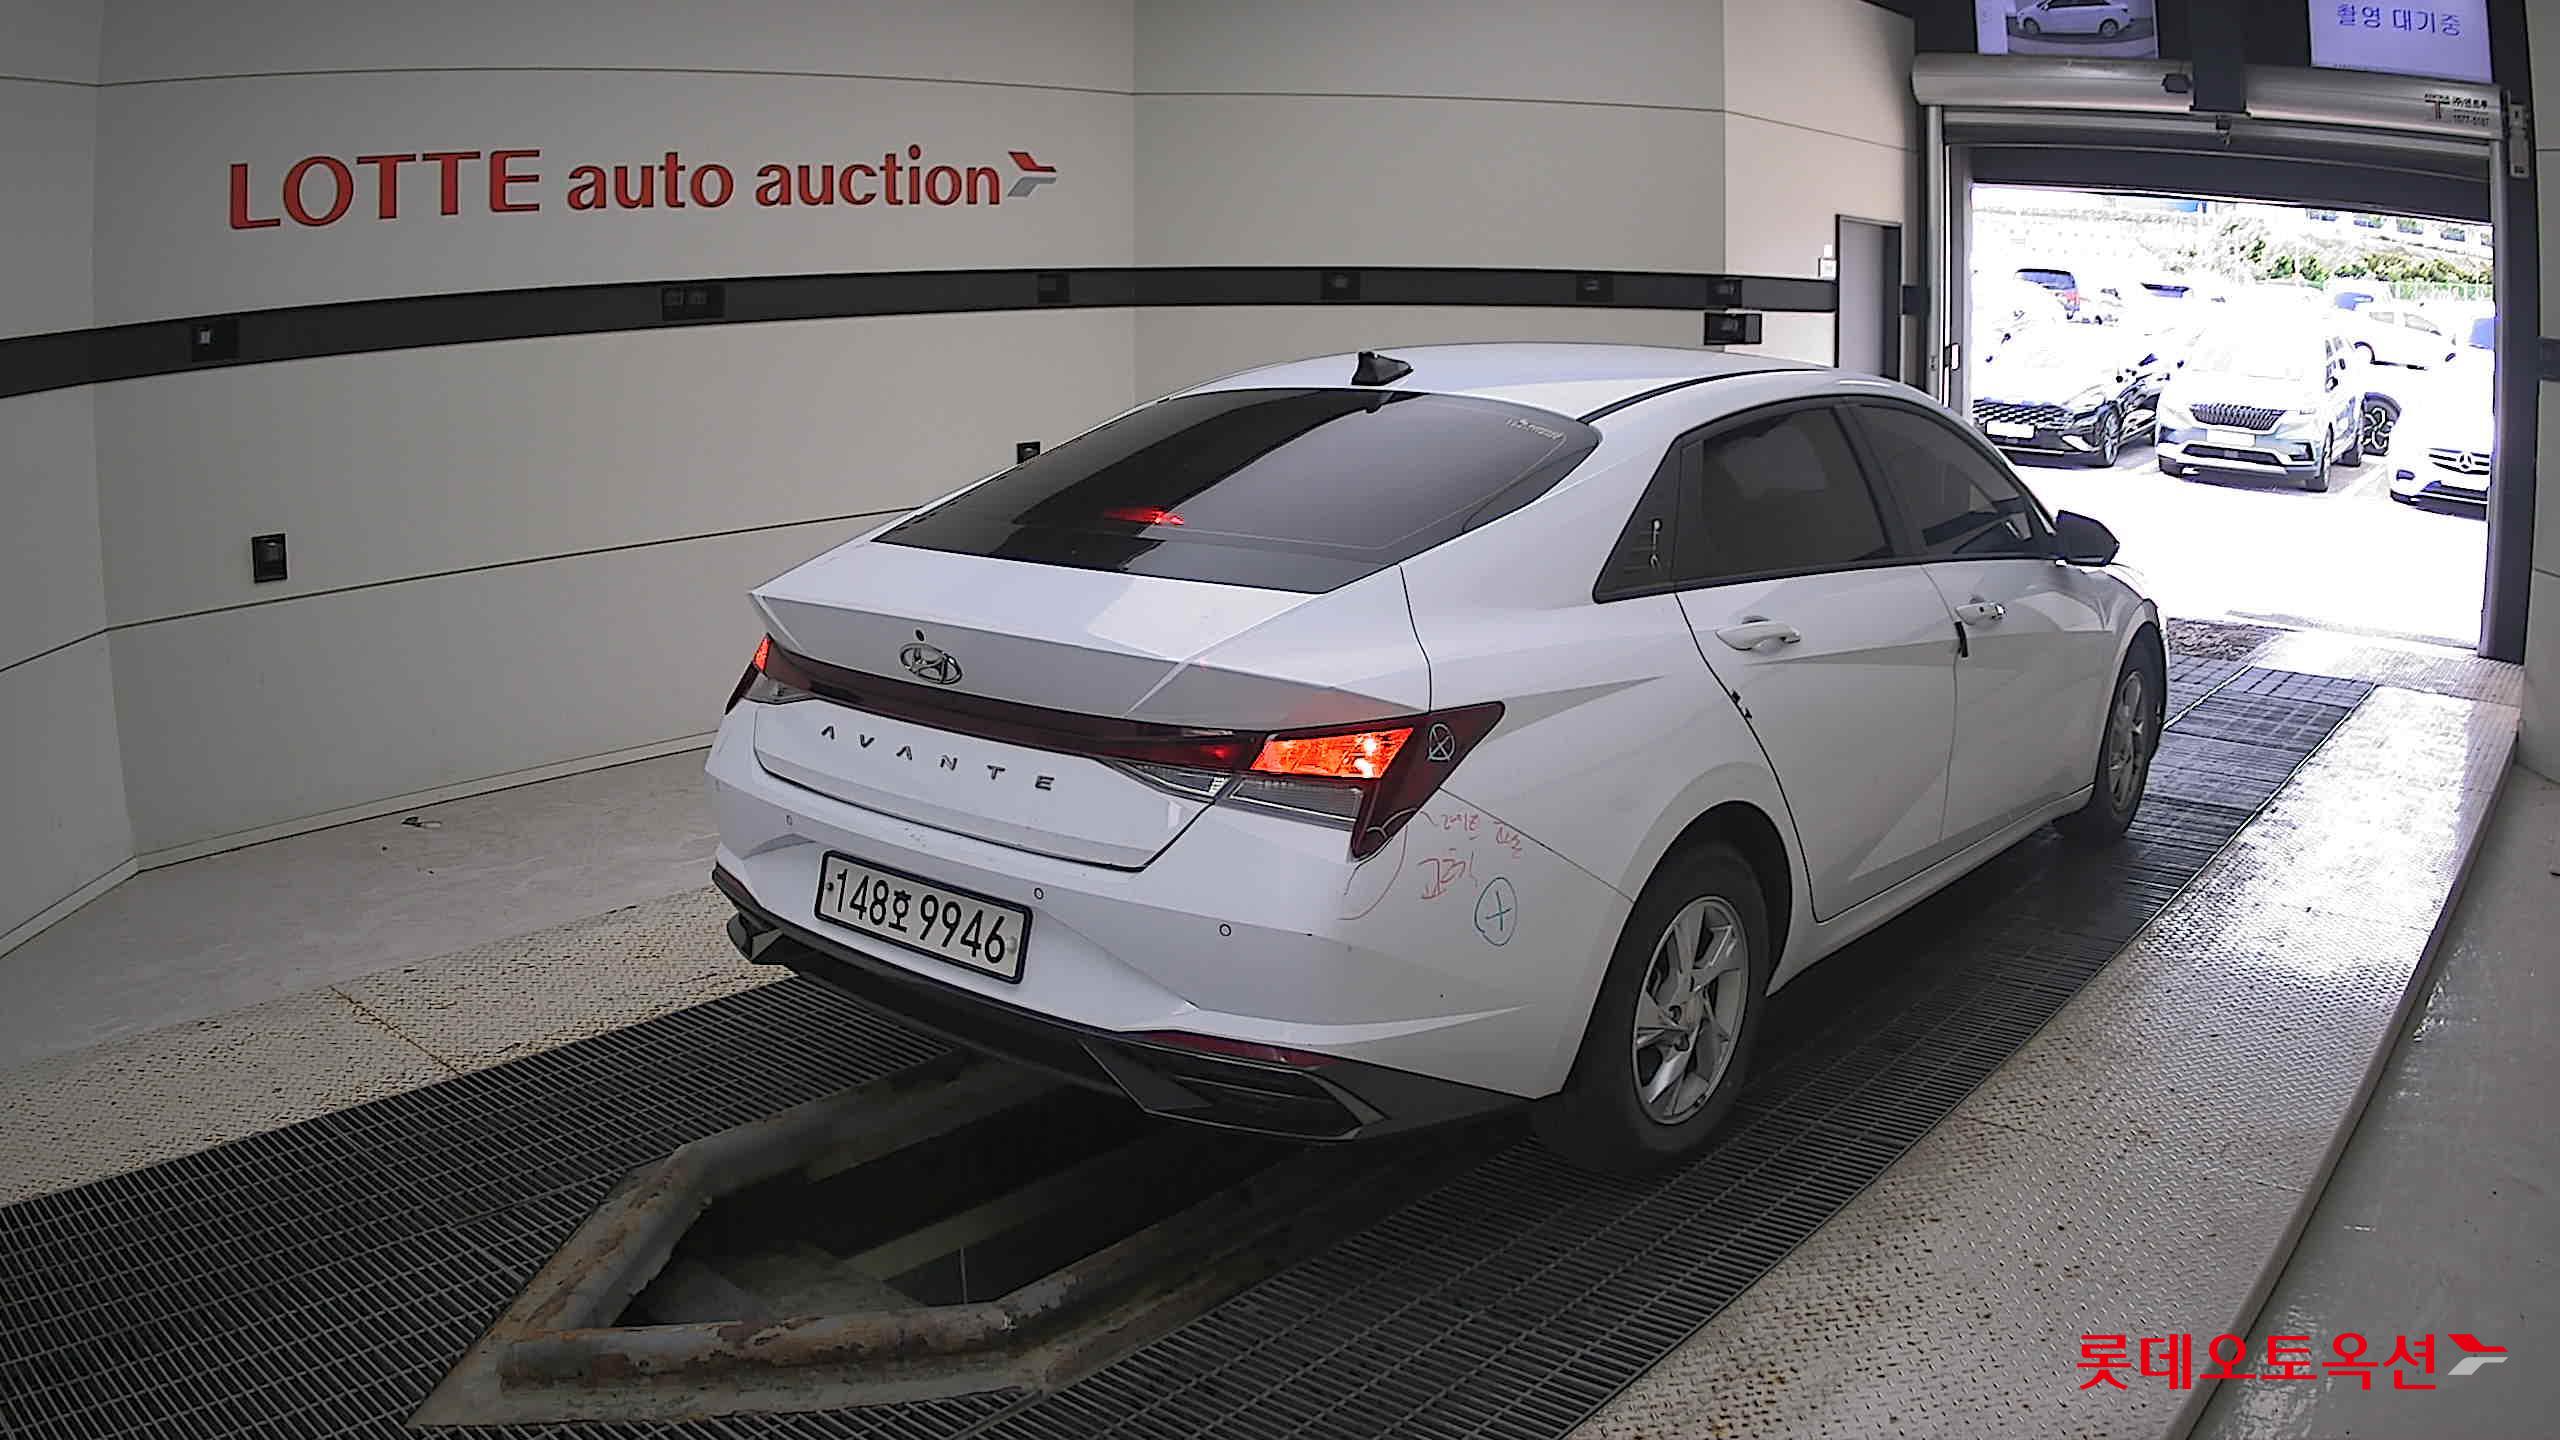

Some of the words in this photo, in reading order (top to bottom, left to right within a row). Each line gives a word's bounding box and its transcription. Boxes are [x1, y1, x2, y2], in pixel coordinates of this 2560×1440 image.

[2392, 8, 2462, 37] 대기중
[228, 149, 541, 231] LOTTE
[566, 151, 735, 211] auto
[755, 144, 1002, 207] auction
[820, 725, 1055, 791] AVANTE
